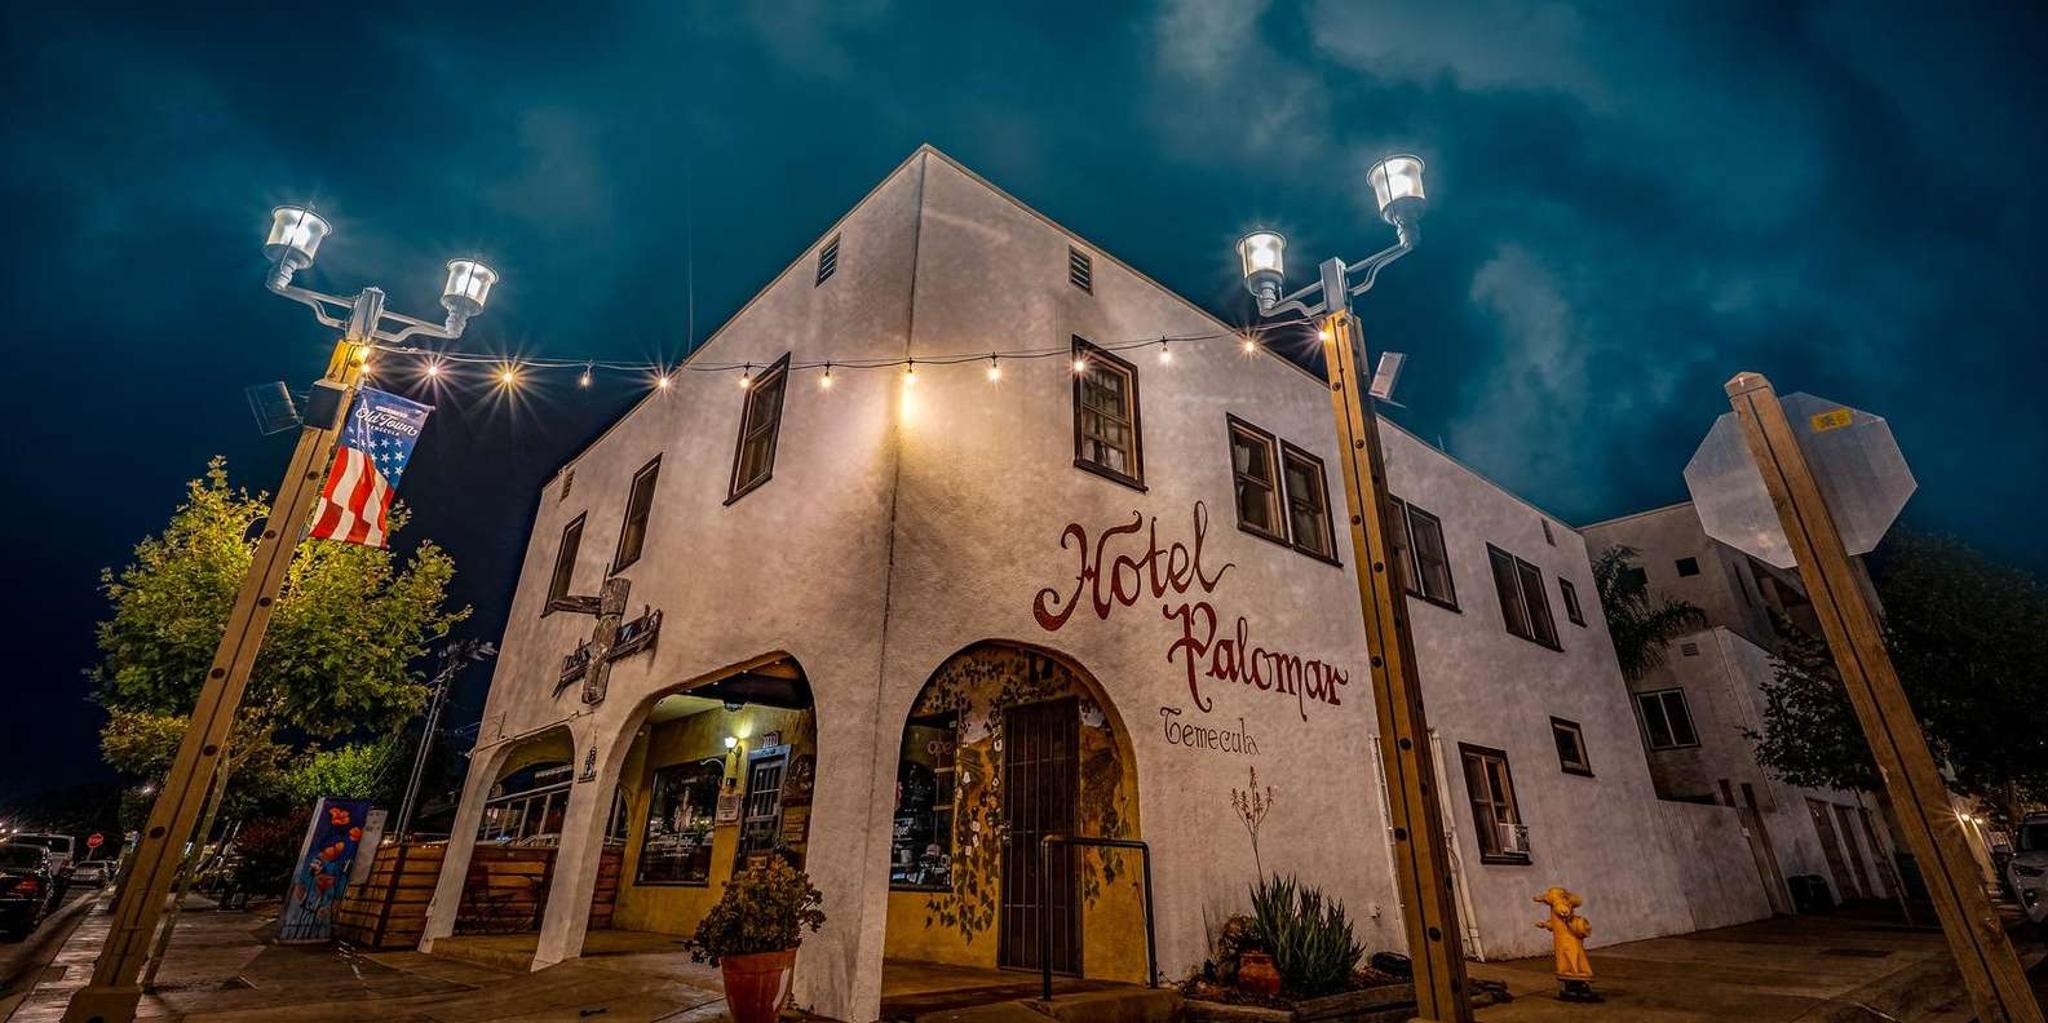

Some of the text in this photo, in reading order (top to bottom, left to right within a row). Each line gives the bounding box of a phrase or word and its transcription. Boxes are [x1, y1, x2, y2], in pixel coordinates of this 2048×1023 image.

[356, 407, 382, 424] Old
[380, 413, 418, 436] Town
[1033, 500, 1236, 632] Hotel
[1162, 601, 1348, 722] Palomar
[1160, 706, 1260, 756] Temecula
